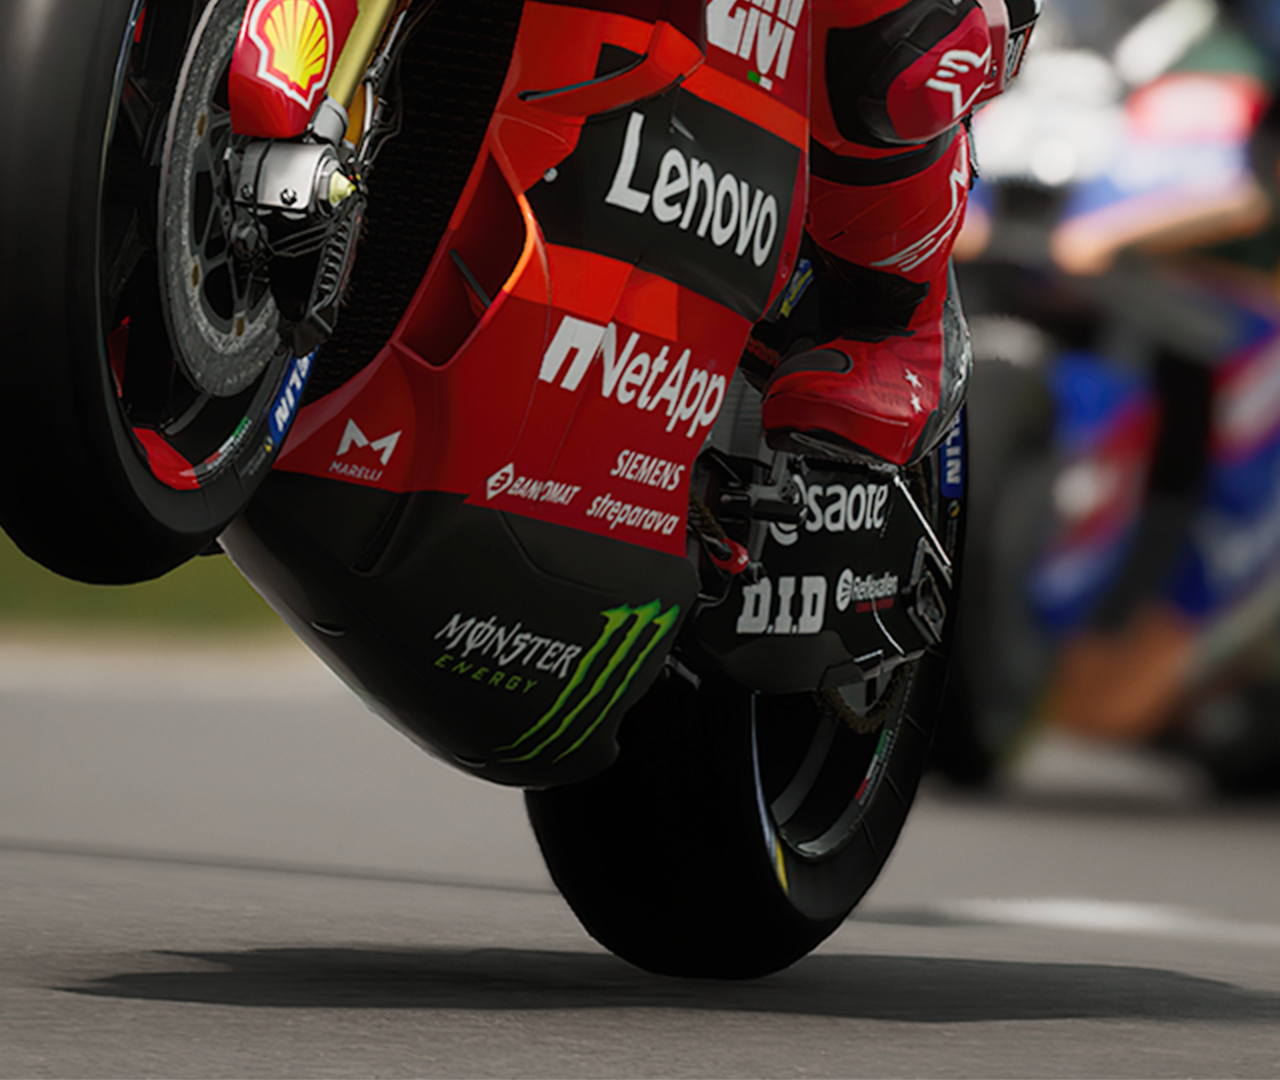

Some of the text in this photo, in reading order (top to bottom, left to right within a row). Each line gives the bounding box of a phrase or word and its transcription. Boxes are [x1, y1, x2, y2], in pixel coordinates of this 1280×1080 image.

[605, 112, 778, 267] Lenovo
[600, 321, 726, 438] NetApp
[328, 460, 384, 482] MARELLI
[610, 449, 686, 492] SIEMENS
[586, 493, 680, 536] streparava
[433, 653, 539, 694] ENERGY
